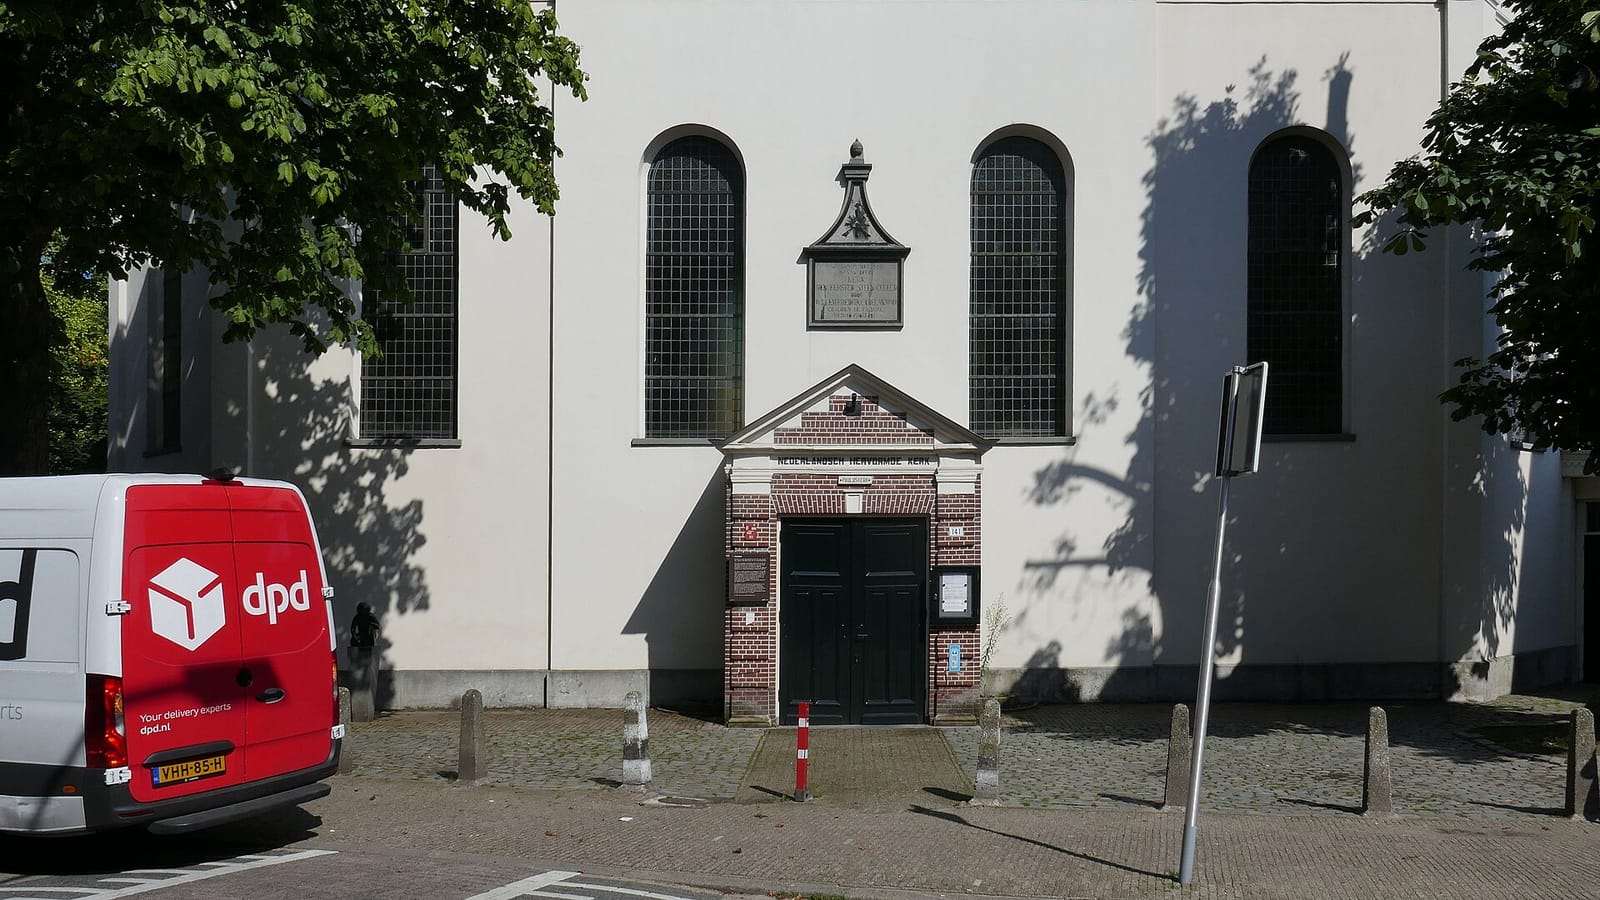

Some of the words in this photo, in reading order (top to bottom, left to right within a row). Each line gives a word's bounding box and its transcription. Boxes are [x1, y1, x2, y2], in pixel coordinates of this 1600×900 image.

[777, 457, 845, 466] NEDERLANDSCH
[849, 457, 902, 466] HERVORMDE
[907, 457, 930, 466] KERK
[242, 569, 311, 625] dpd
[140, 713, 163, 723] Your
[163, 708, 199, 719] delivery
[200, 703, 232, 715] experts
[140, 722, 171, 735] dpd.nl
[162, 757, 222, 781] VHH-85-H
